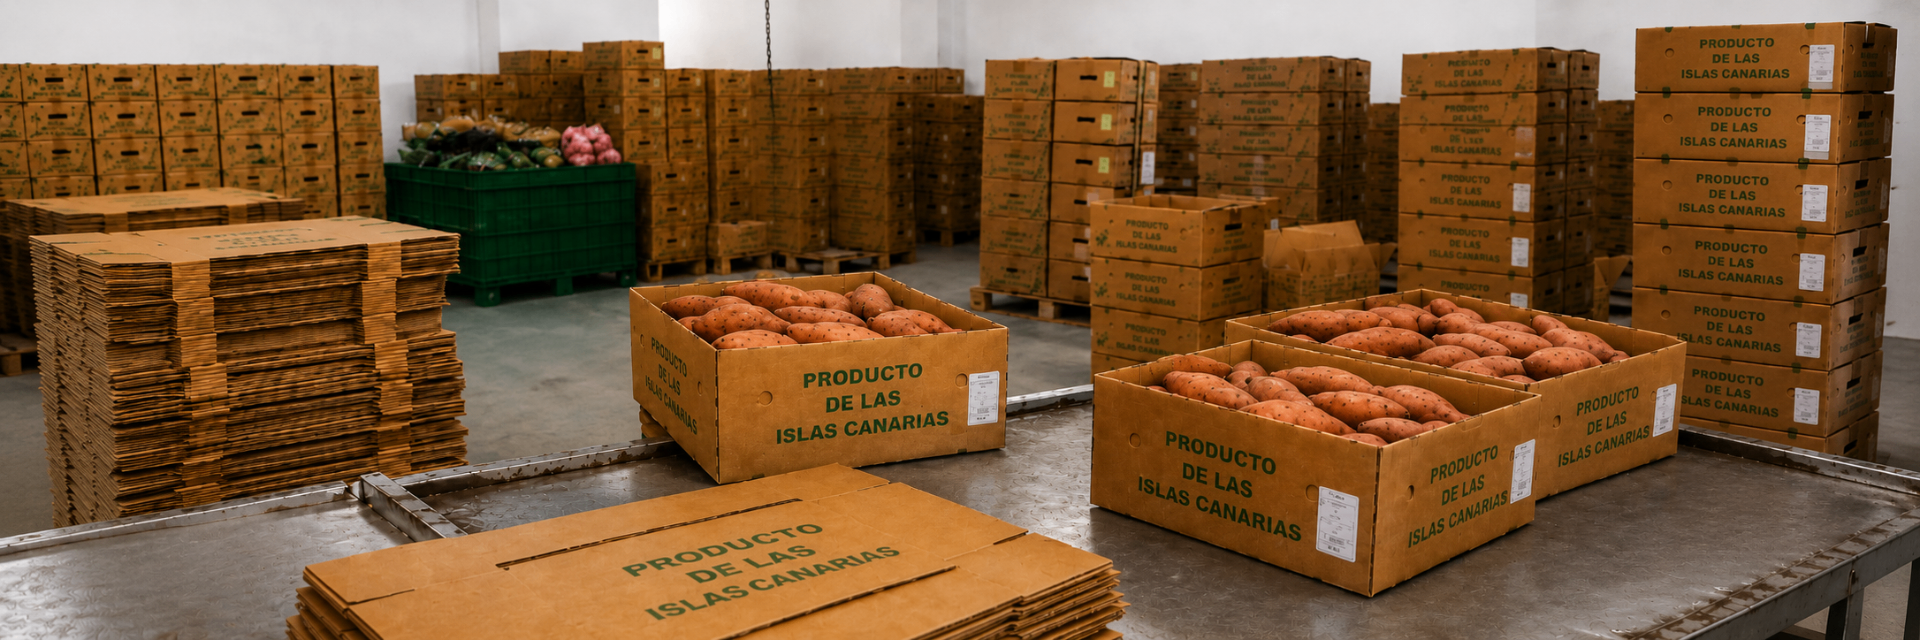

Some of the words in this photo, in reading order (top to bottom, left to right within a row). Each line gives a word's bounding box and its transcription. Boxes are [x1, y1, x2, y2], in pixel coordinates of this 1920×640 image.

[1700, 38, 1774, 49] PRODUCTO
[1712, 54, 1729, 64] DE
[1734, 54, 1760, 63] LAS
[1681, 69, 1718, 79] ISLAS
[1722, 69, 1790, 79] CANARIAS
[1698, 107, 1771, 117] PRODUCTO
[1710, 122, 1727, 132] DE
[1732, 122, 1758, 132] LAS
[1680, 136, 1716, 146] ISLAS
[1720, 138, 1787, 148] CANARIAS
[1431, 145, 1455, 154] ISLAS
[1457, 146, 1502, 156] CANARIAS
[1441, 174, 1490, 184] PRODUCTO
[1696, 174, 1769, 186] PRODUCTO
[1450, 186, 1462, 194] DE
[1465, 187, 1482, 195] LAS
[1709, 189, 1726, 199] DE
[1731, 190, 1756, 200] LAS
[1430, 197, 1455, 205] ISLAS
[1457, 198, 1502, 208] CANARIAS
[1679, 203, 1714, 214] ISLAS
[1718, 205, 1786, 218] CANARIAS
[1441, 227, 1489, 238] PRODUCTO
[1449, 239, 1461, 248] DE
[1464, 240, 1481, 249] LAS
[1695, 240, 1768, 254] PRODUCTO
[1429, 250, 1454, 258] ISLAS
[1456, 251, 1499, 263] CANARIAS
[1708, 256, 1725, 266] DE
[1729, 258, 1754, 268] LAS
[1678, 269, 1713, 279] ISLAS
[1718, 272, 1783, 285] CANARIAS
[1694, 306, 1766, 321] PRODUCTO
[1706, 321, 1723, 332] DE
[1728, 323, 1753, 335] LAS
[1716, 337, 1781, 352] CANARIAS
[652, 337, 687, 377] PRODUCTO
[659, 364, 666, 383] DE
[668, 372, 680, 396] LAS
[804, 363, 922, 388] PRODUCTO
[1692, 369, 1764, 386] PRODUCTO
[1705, 384, 1722, 395] DE
[1726, 387, 1751, 399] LAS
[645, 375, 662, 401] ISLAS
[664, 393, 697, 435] CANARIAS
[826, 395, 853, 413] DE
[861, 391, 901, 408] LAS
[1576, 386, 1639, 416] PRODUCTO
[1682, 396, 1710, 408] SLAS
[1714, 400, 1778, 418] CANARIAS
[776, 424, 837, 444] ISLAS
[844, 411, 949, 436] CANARIAS
[1587, 419, 1602, 436] DE
[1606, 411, 1627, 430] LAS
[1166, 430, 1276, 475] PRODUCTO
[1558, 445, 1591, 467] ISLAS
[1595, 426, 1649, 454] CANARIAS
[1431, 445, 1498, 484] PRODUCTO
[1182, 462, 1208, 485] DE
[1215, 470, 1253, 498] LAS
[1442, 488, 1458, 505] DE
[1462, 475, 1484, 494] LAS
[1138, 476, 1191, 507] ISLAS
[1196, 495, 1302, 541] CANARIAS
[1408, 518, 1444, 547] ISLAS
[1449, 490, 1508, 528] CANARIAS
[622, 524, 822, 577] PRODUCTO
[686, 562, 743, 583] DE
[743, 545, 816, 568] LAS
[644, 585, 749, 620] ISLAS
[749, 547, 900, 591] CANARIAS
